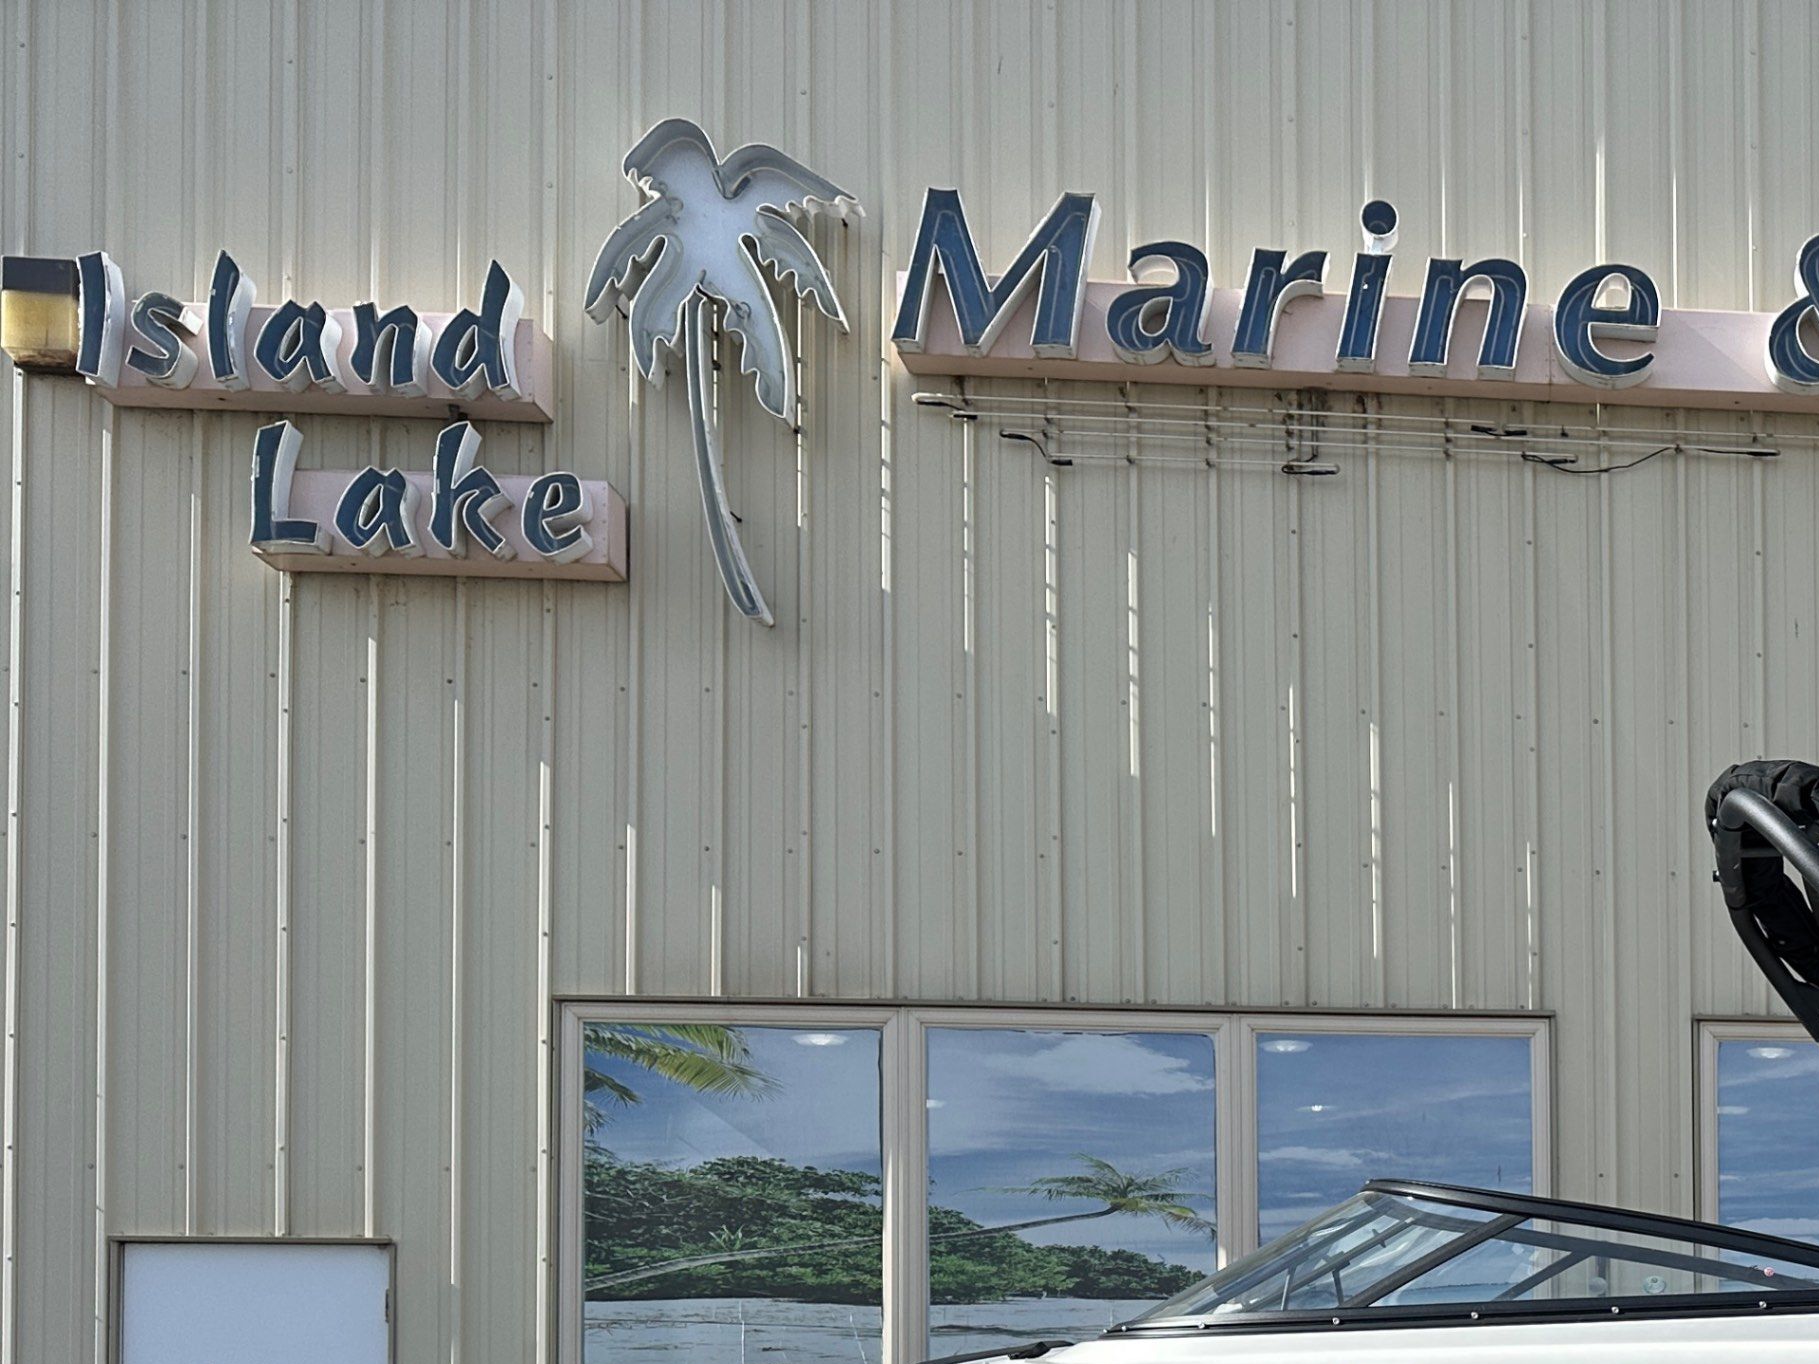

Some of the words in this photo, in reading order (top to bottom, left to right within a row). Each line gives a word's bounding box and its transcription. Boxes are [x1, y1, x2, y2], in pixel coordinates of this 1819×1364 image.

[76, 249, 524, 400] Island
[891, 187, 1661, 388] Marine
[251, 420, 592, 564] Lake
